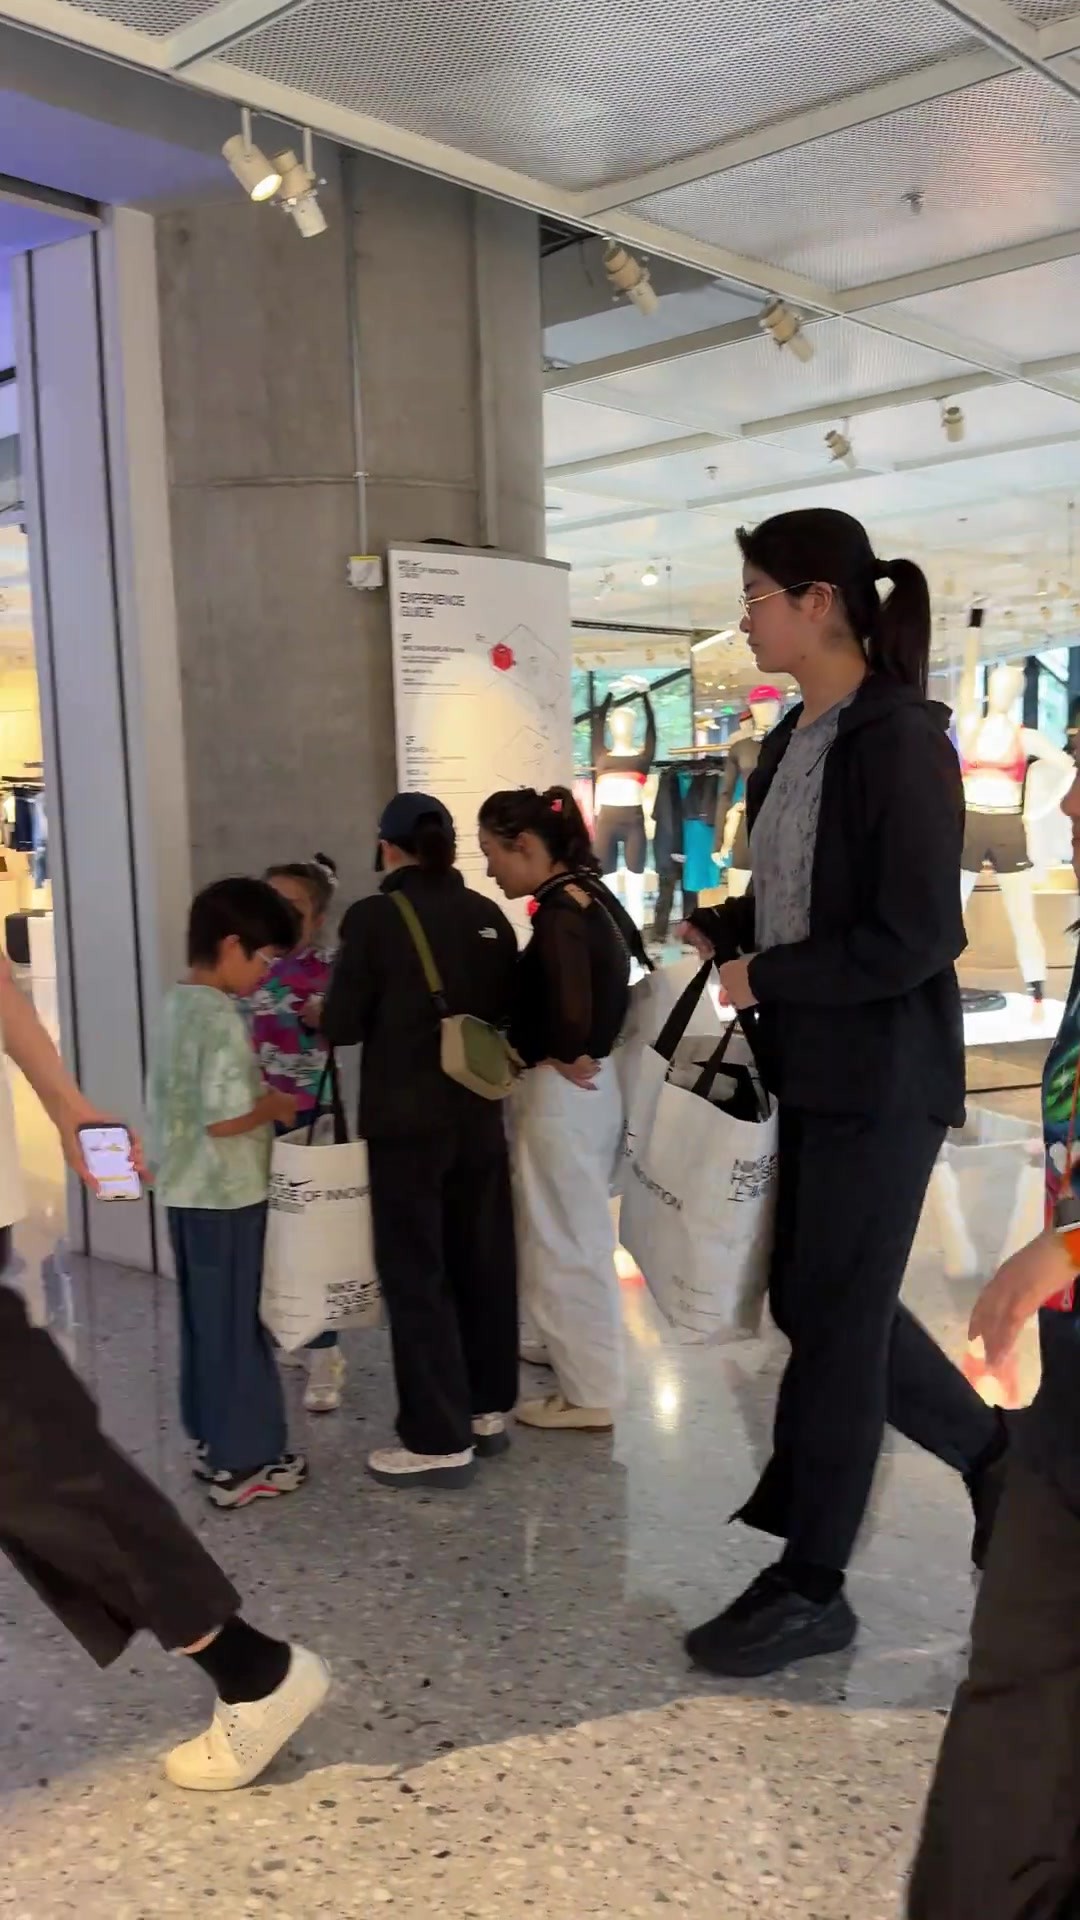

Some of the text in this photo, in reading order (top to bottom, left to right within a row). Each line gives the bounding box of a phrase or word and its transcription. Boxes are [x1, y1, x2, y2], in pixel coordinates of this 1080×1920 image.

[400, 592, 466, 607] EXPERIENCE
[401, 606, 435, 618] GUIDE
[304, 1190, 323, 1202] OF
[327, 1279, 358, 1294] NIKE
[326, 1289, 371, 1306] HOUSE
